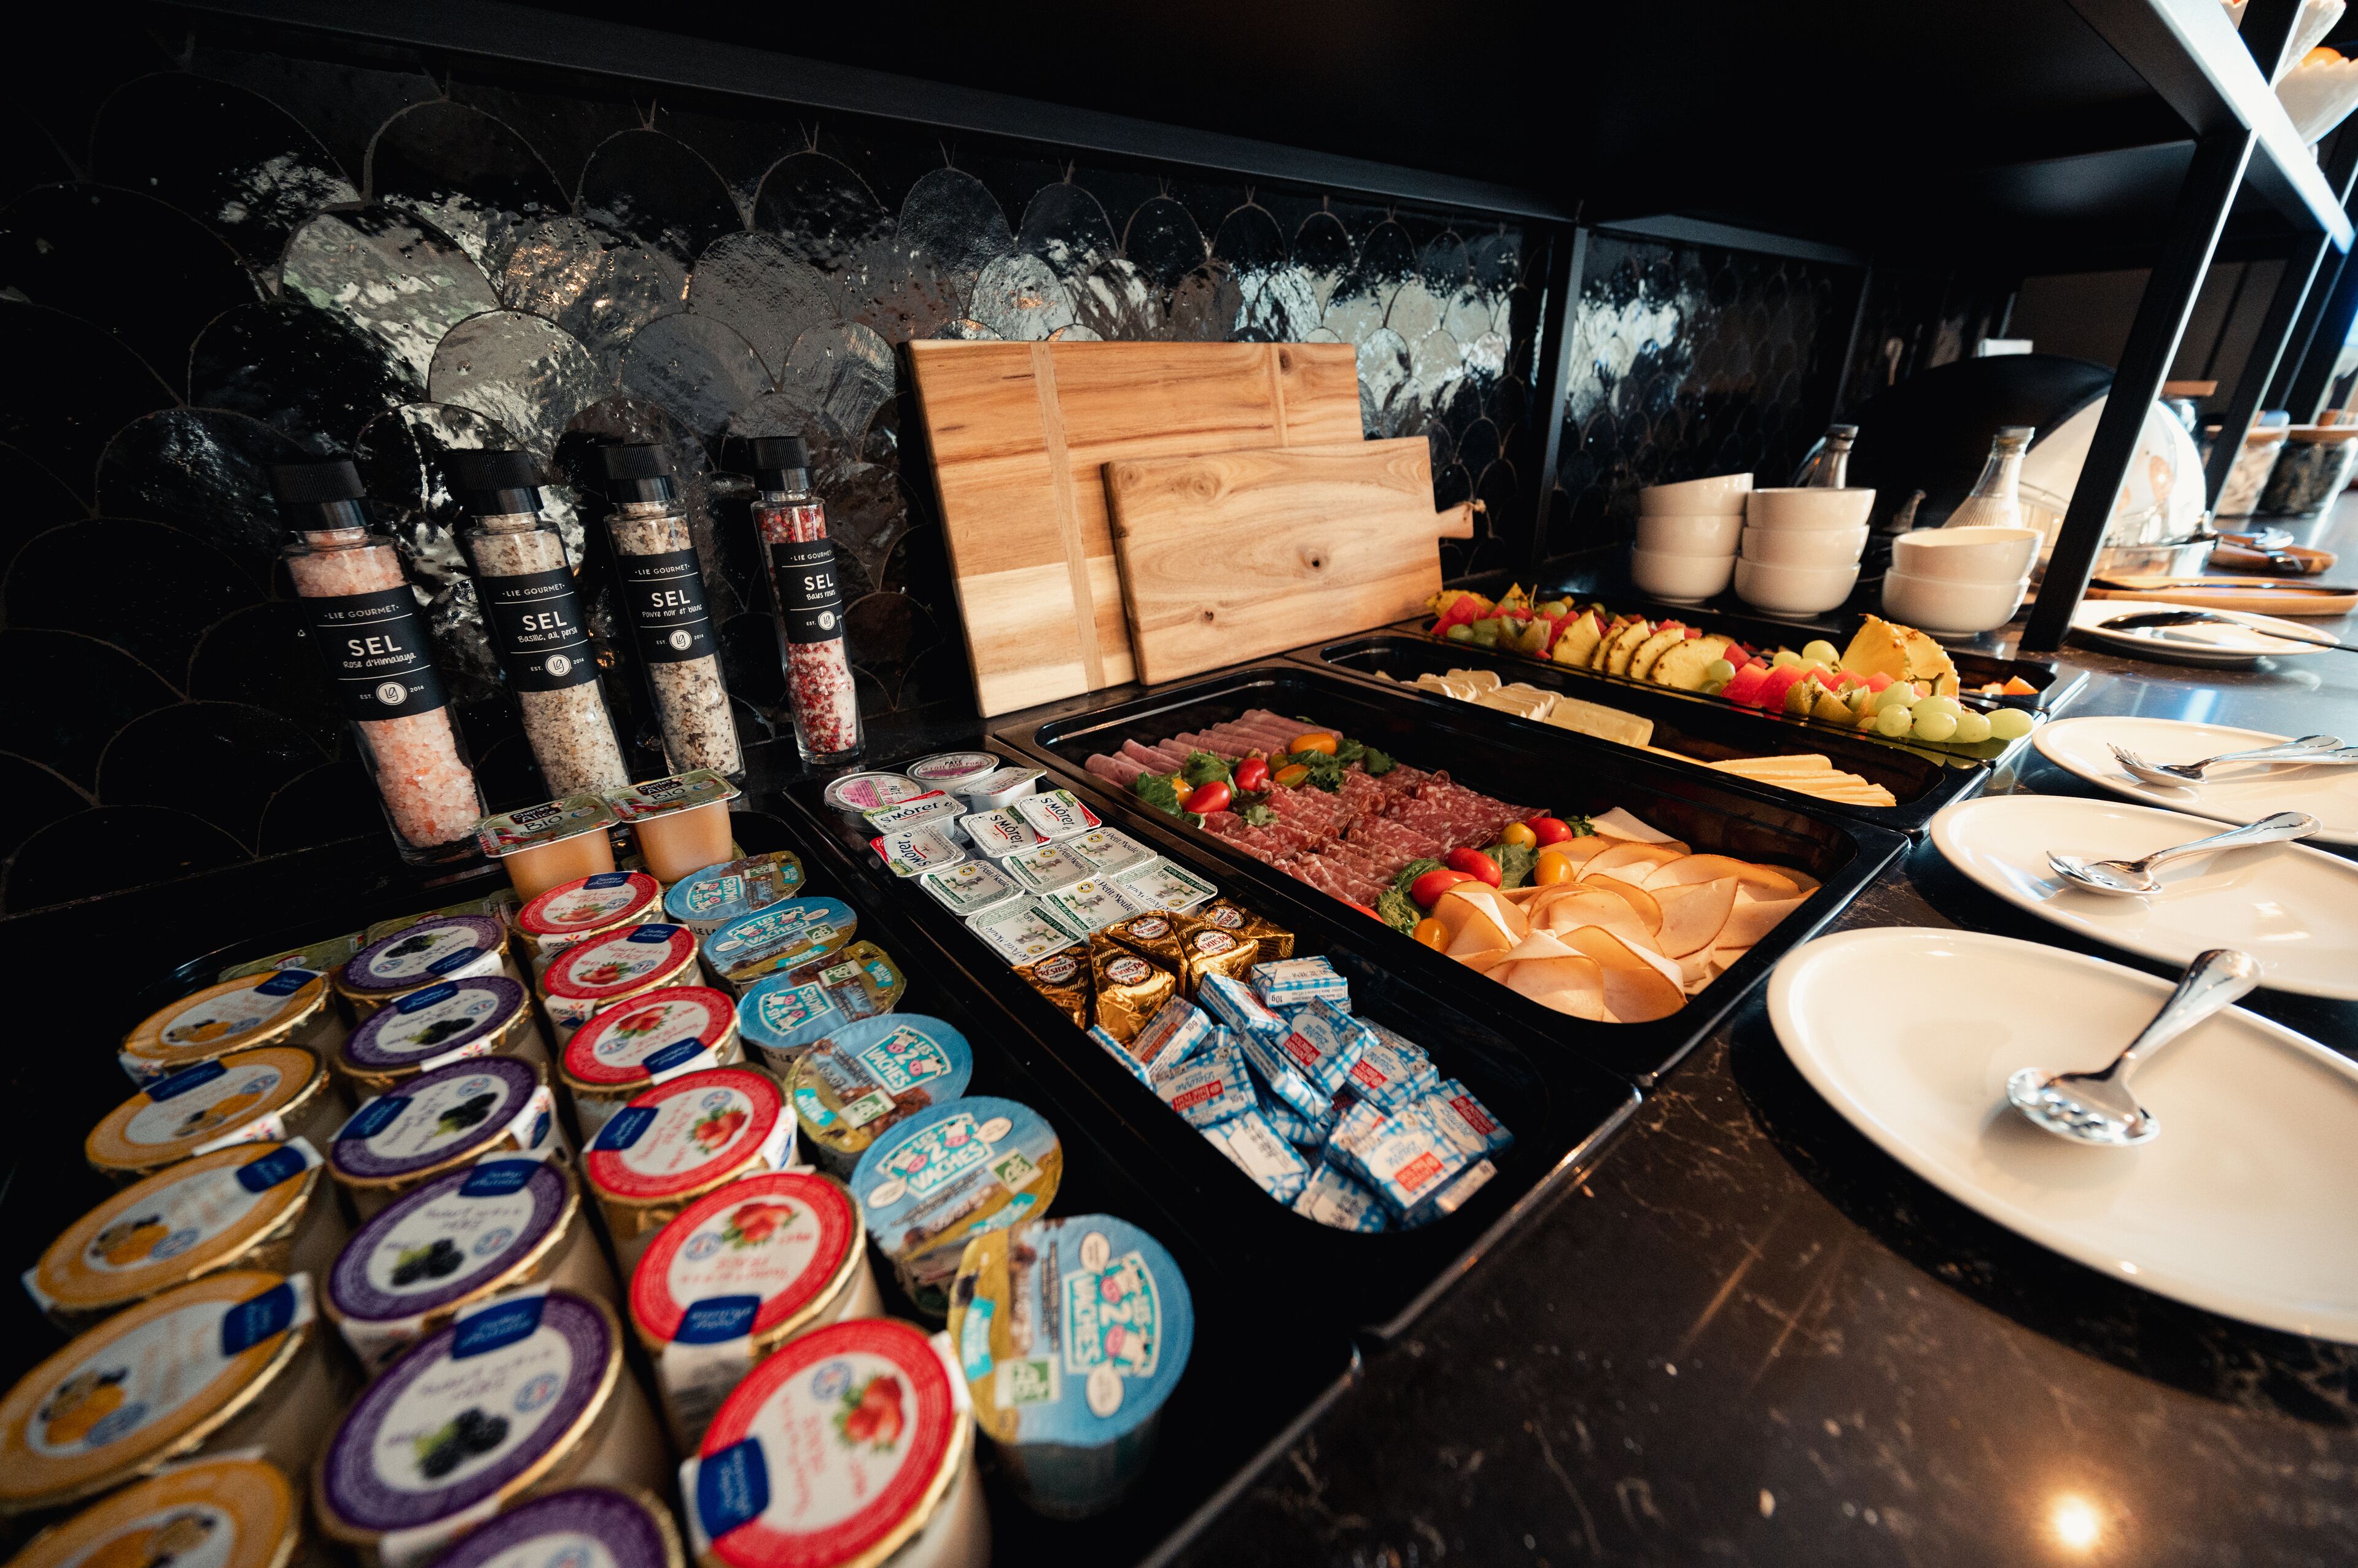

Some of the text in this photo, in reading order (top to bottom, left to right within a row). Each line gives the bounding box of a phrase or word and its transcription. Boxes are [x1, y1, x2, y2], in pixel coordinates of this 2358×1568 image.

[807, 550, 831, 559] GOURMET
[653, 564, 688, 574] GOURMET
[524, 583, 562, 596] GOURMET
[804, 573, 834, 591] SEL
[652, 590, 691, 607] SEL
[806, 592, 823, 600] Baies
[348, 604, 396, 618] GOURMET
[688, 604, 702, 613] blanc
[523, 611, 567, 631] SEL
[561, 626, 578, 639] persil
[348, 635, 402, 657] SEL
[365, 652, 417, 667] d'Himalaya
[639, 779, 671, 791] Charles
[647, 783, 679, 794] Alice
[514, 805, 550, 819] Charles
[522, 810, 556, 823] Alice
[891, 801, 940, 821] Môret
[1049, 802, 1076, 826] Môret
[999, 817, 1024, 844] Môret
[1105, 831, 1121, 845] Petit
[1121, 840, 1139, 853] Moulé
[897, 839, 923, 866] Môret
[1059, 847, 1072, 860] Petit
[1071, 856, 1085, 870] Moulé
[979, 864, 994, 879] Petit
[994, 874, 1010, 888] Moulé
[1166, 866, 1178, 876] Herbes
[1177, 872, 1186, 881] Fines
[725, 877, 737, 902] VACHES
[1097, 879, 1113, 896] Petit
[1113, 892, 1134, 912] Moulé
[1194, 882, 1213, 895] Fromage
[1033, 906, 1044, 918] Herbes
[1047, 893, 1064, 908] Fromage
[1068, 910, 1078, 922] Fines
[1077, 919, 1088, 930] Herbes
[757, 917, 776, 926] LES
[766, 922, 777, 931] 2
[1043, 915, 1054, 925] Fines
[749, 920, 804, 944] VACHES
[811, 926, 830, 940] AB
[800, 985, 826, 1016] VACHES
[1271, 995, 1283, 1003] 10g
[1185, 1020, 1198, 1031] 10g
[917, 1040, 934, 1056] LES
[893, 1048, 920, 1066] 2
[866, 1047, 911, 1090] VACHES
[925, 1143, 950, 1162] 2
[911, 1141, 984, 1190] VACHES
